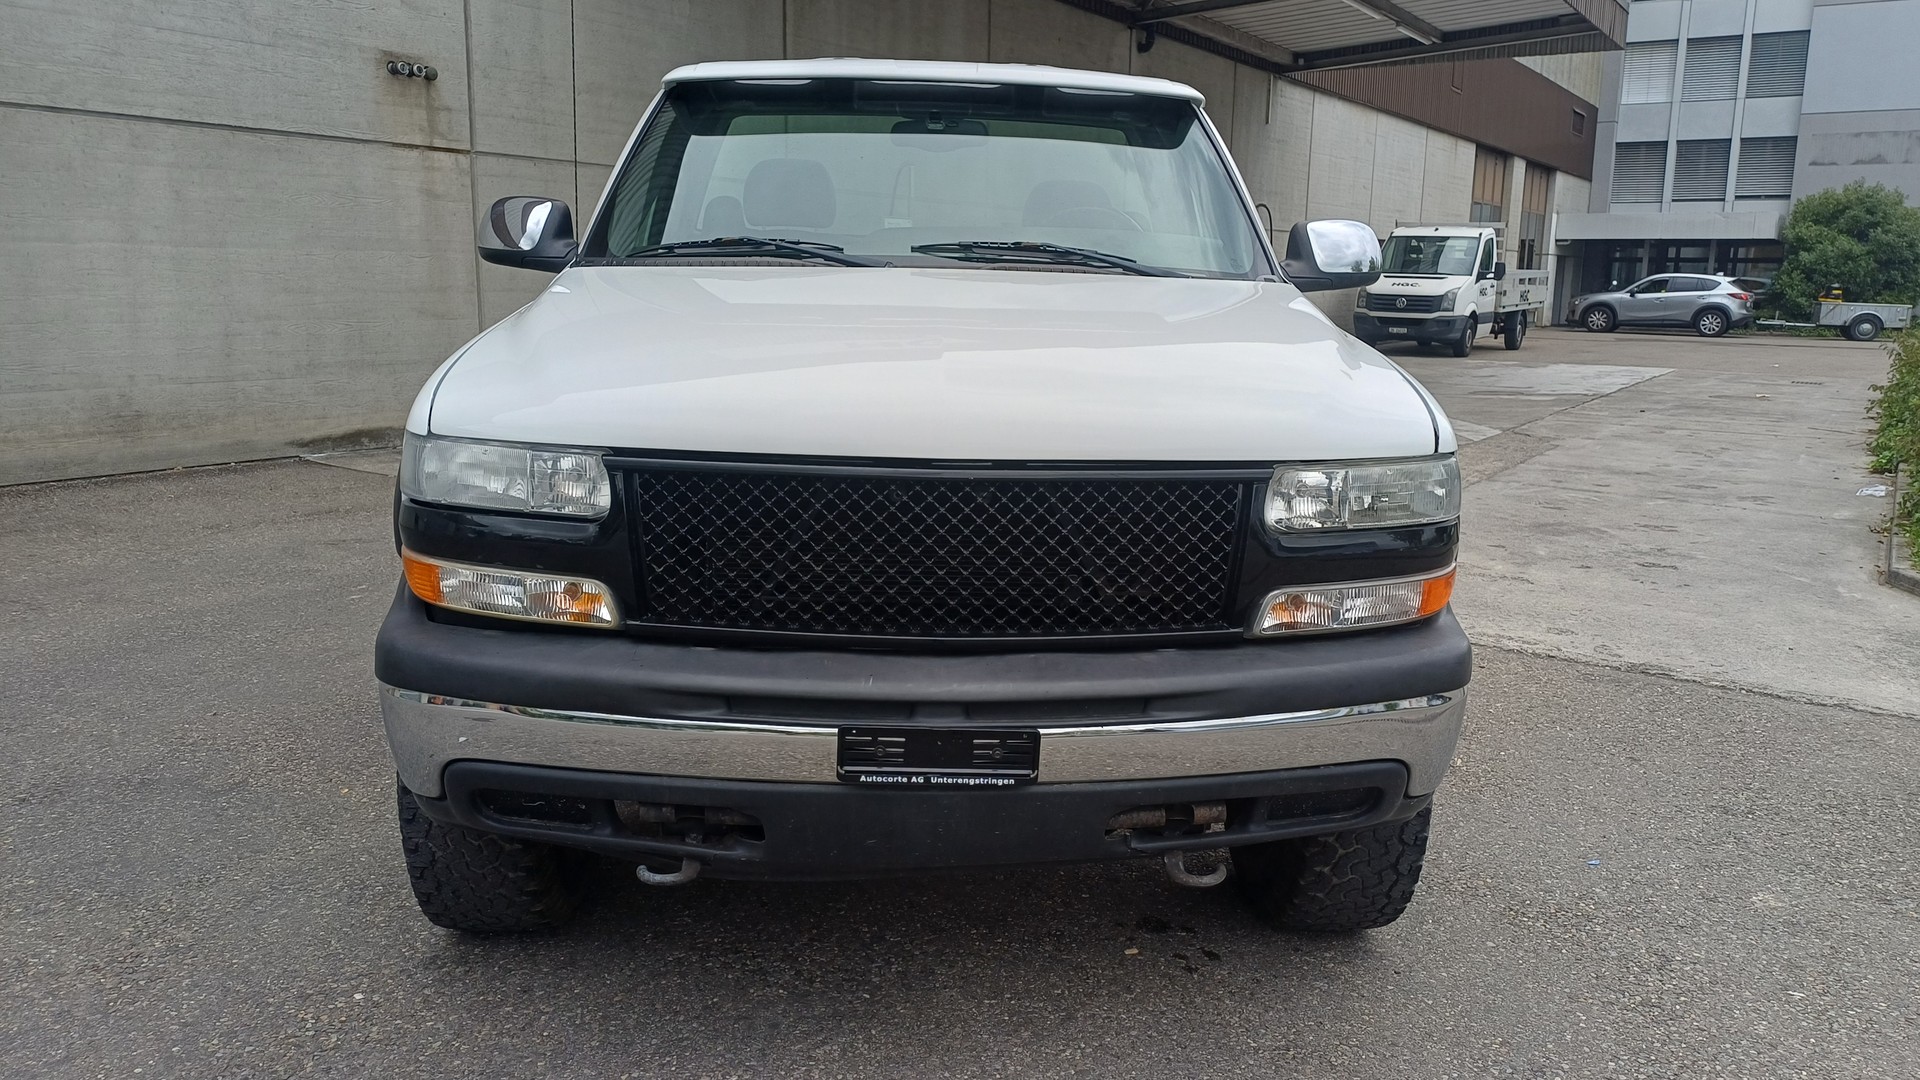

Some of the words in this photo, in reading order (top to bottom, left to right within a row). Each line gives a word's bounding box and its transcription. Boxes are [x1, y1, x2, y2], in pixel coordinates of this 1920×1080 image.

[1519, 289, 1530, 302] HGC
[860, 775, 908, 783] Autocorte
[931, 776, 1015, 786] Unterengstringen
